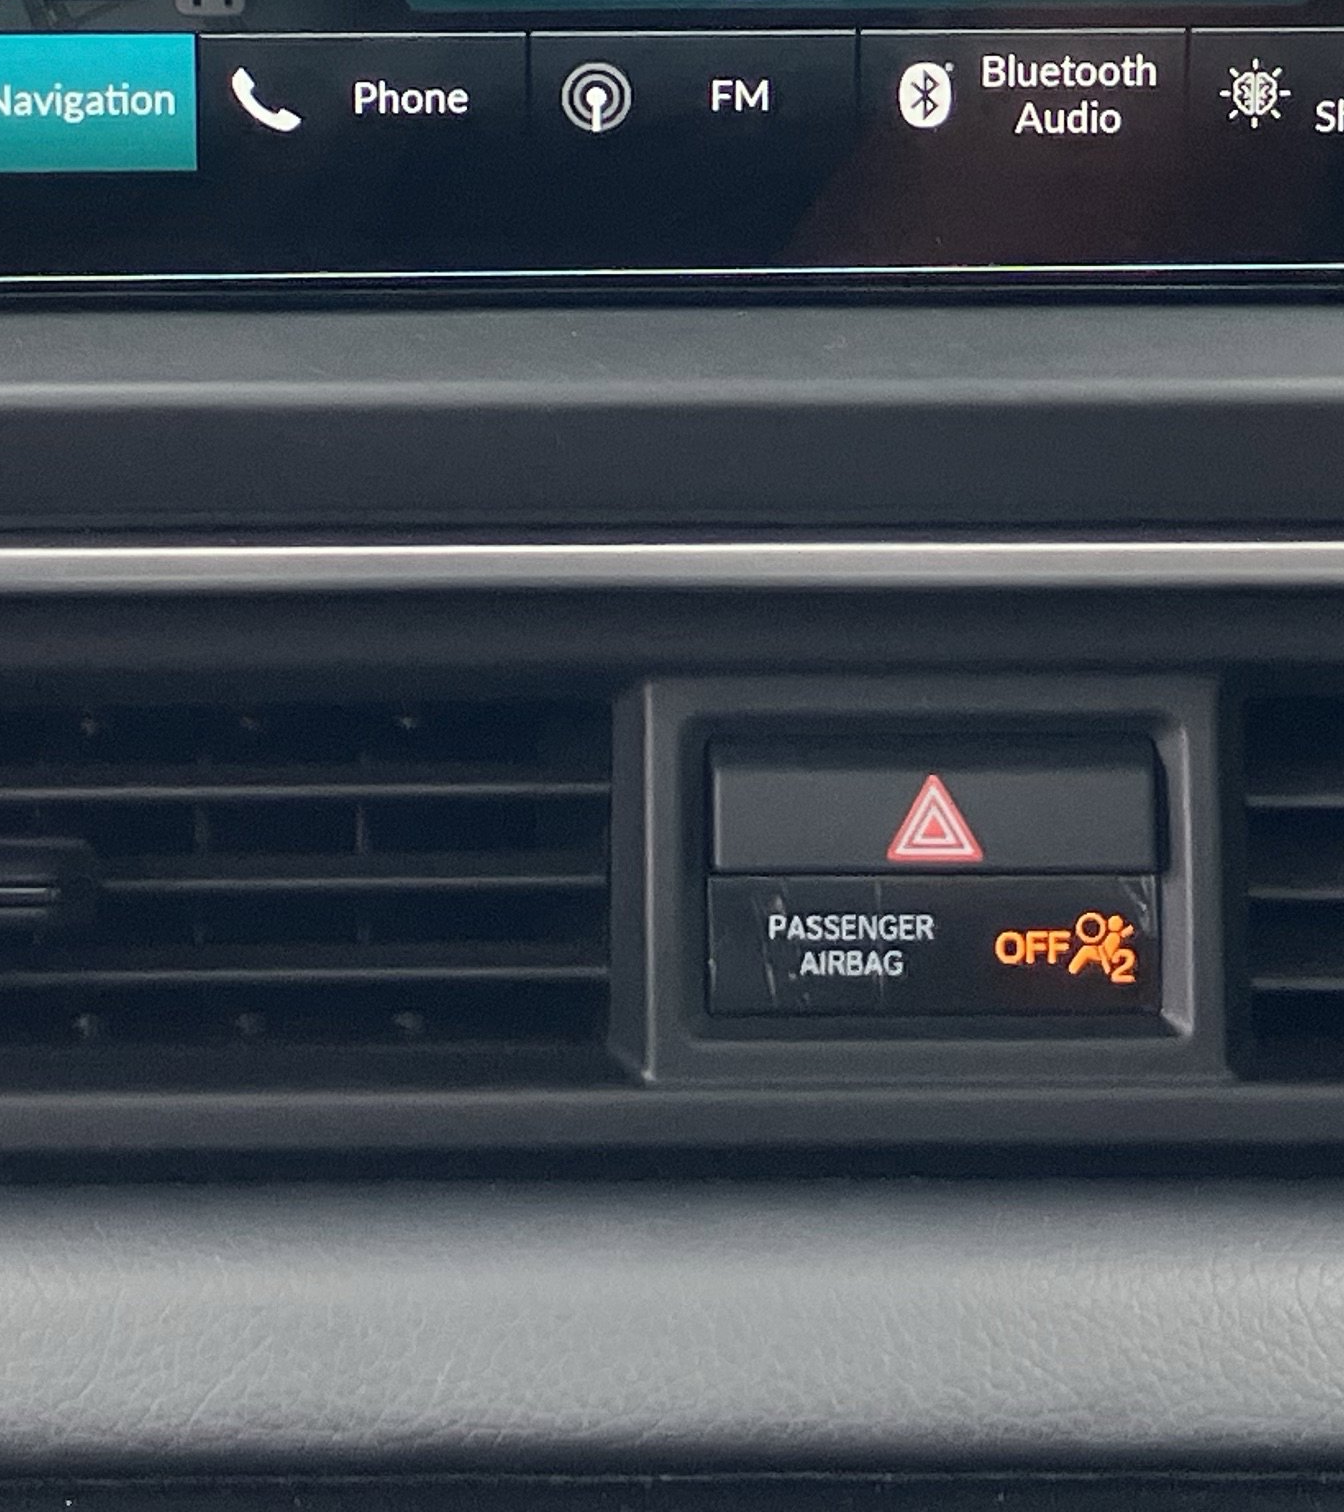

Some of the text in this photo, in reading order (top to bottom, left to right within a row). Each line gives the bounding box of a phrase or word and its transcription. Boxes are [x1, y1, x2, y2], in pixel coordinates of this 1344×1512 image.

[982, 53, 1158, 88] Bluetooth
[354, 79, 469, 115] Phone
[712, 79, 770, 113] FM
[1014, 99, 1123, 135] Audio
[767, 913, 936, 942] PASSENGER
[799, 949, 905, 978] AIRBAG
[994, 930, 1072, 966] OFF
